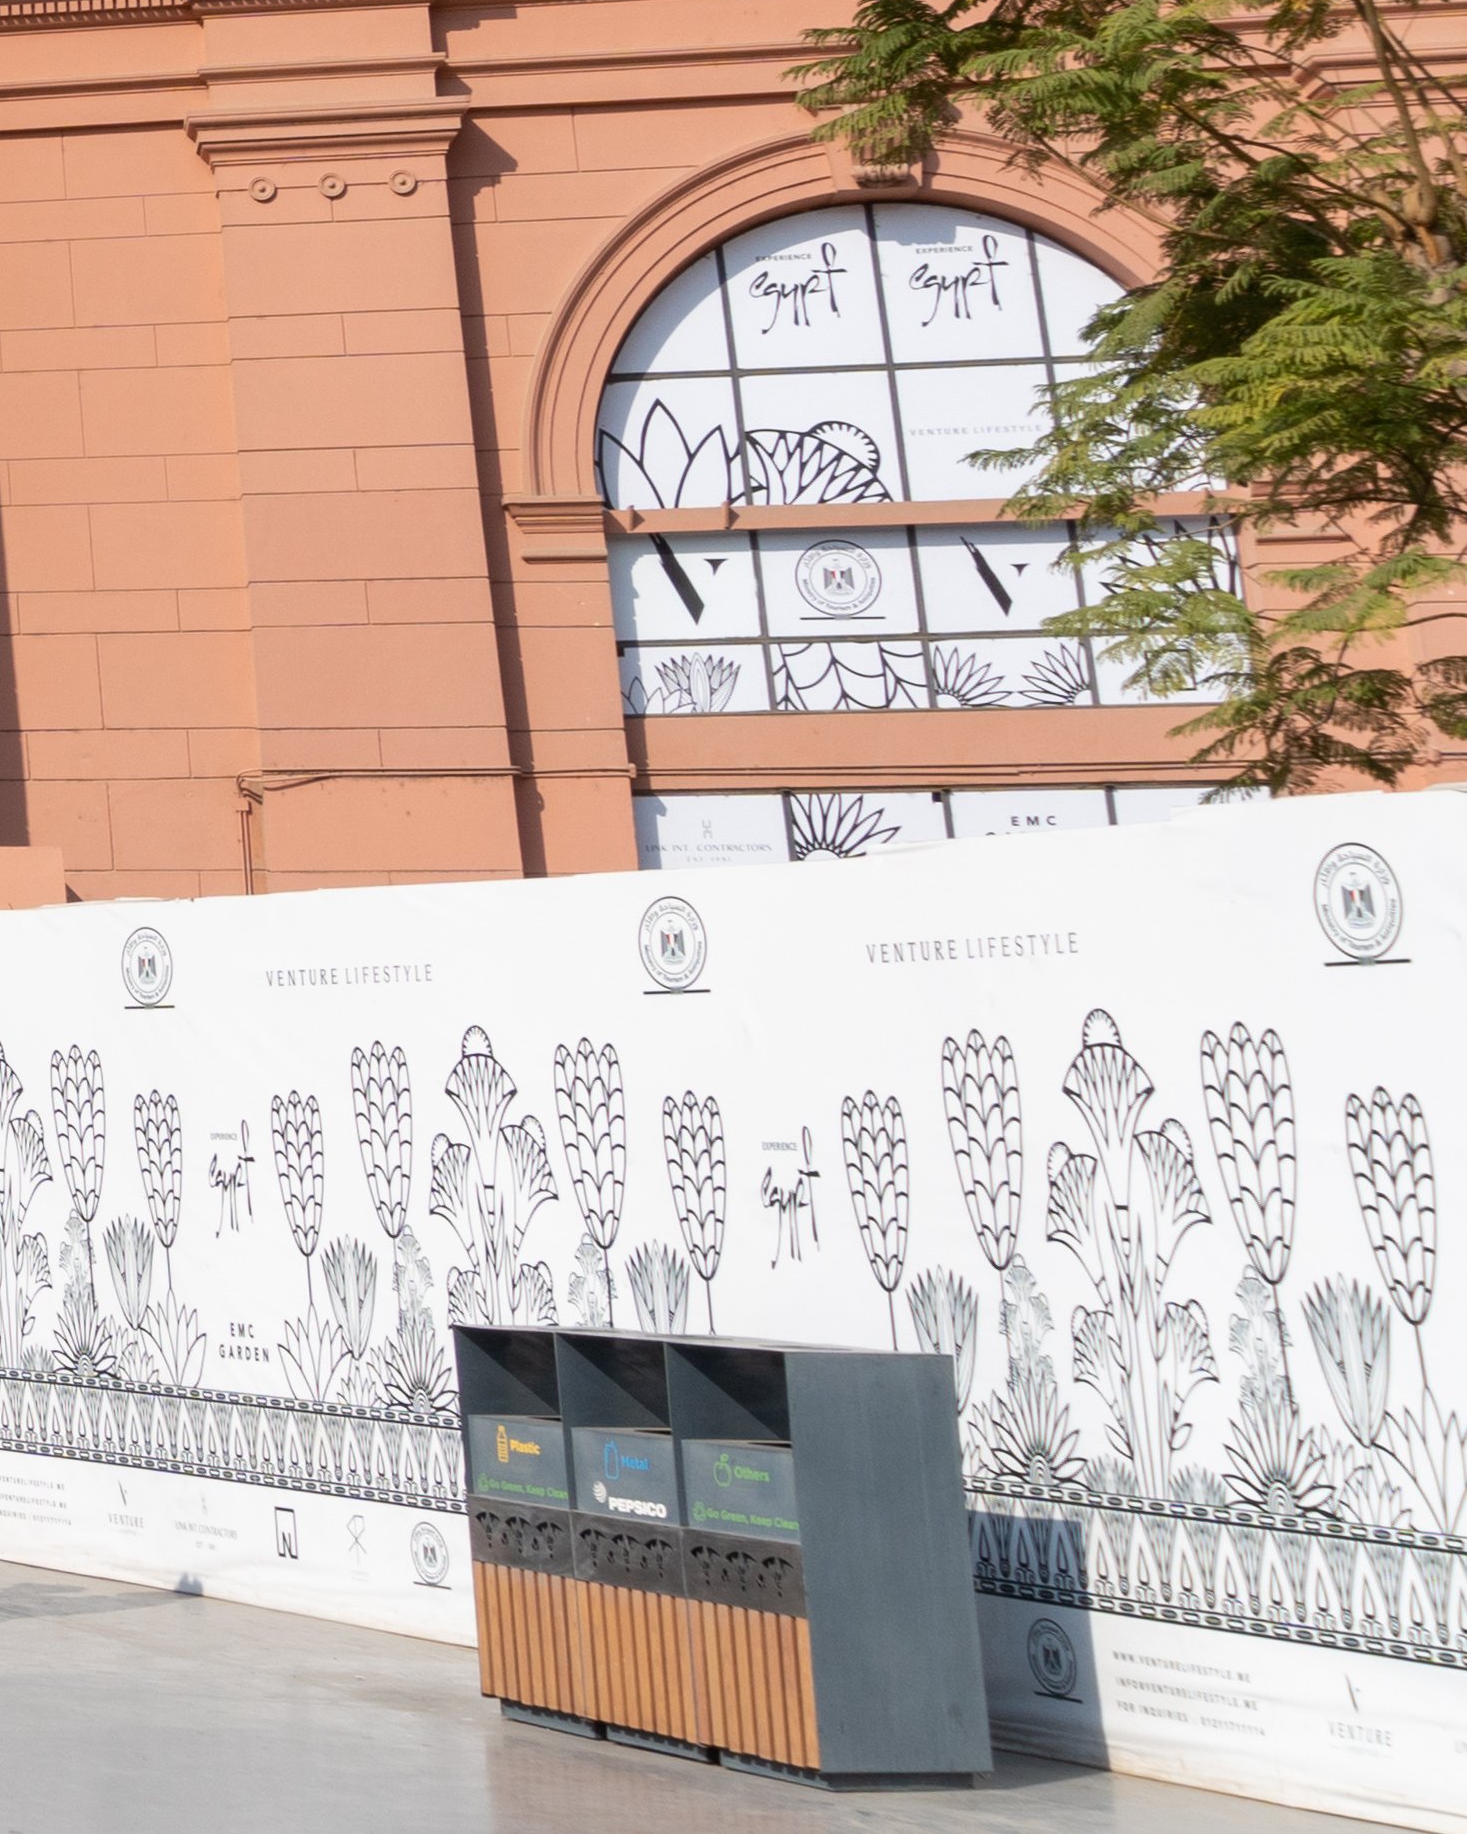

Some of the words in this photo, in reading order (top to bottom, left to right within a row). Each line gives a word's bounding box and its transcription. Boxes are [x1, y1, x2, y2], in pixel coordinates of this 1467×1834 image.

[755, 253, 813, 262] EXPERIENCE
[915, 245, 974, 255] EXPERIENCE
[1011, 815, 1058, 827] EMC
[866, 939, 957, 964] VENTURE
[965, 931, 1079, 960] LIFESTYLE
[266, 967, 339, 987] VENTURE
[344, 964, 433, 985] LIFESTYLE
[761, 1141, 798, 1152] EXPERIENCE
[230, 1322, 255, 1340] EMC
[219, 1344, 270, 1364] GARDEN
[510, 1439, 541, 1456] Plastic
[620, 1454, 649, 1471] Metal
[732, 1466, 771, 1483] Others
[608, 1495, 668, 1519] PEPSICO
